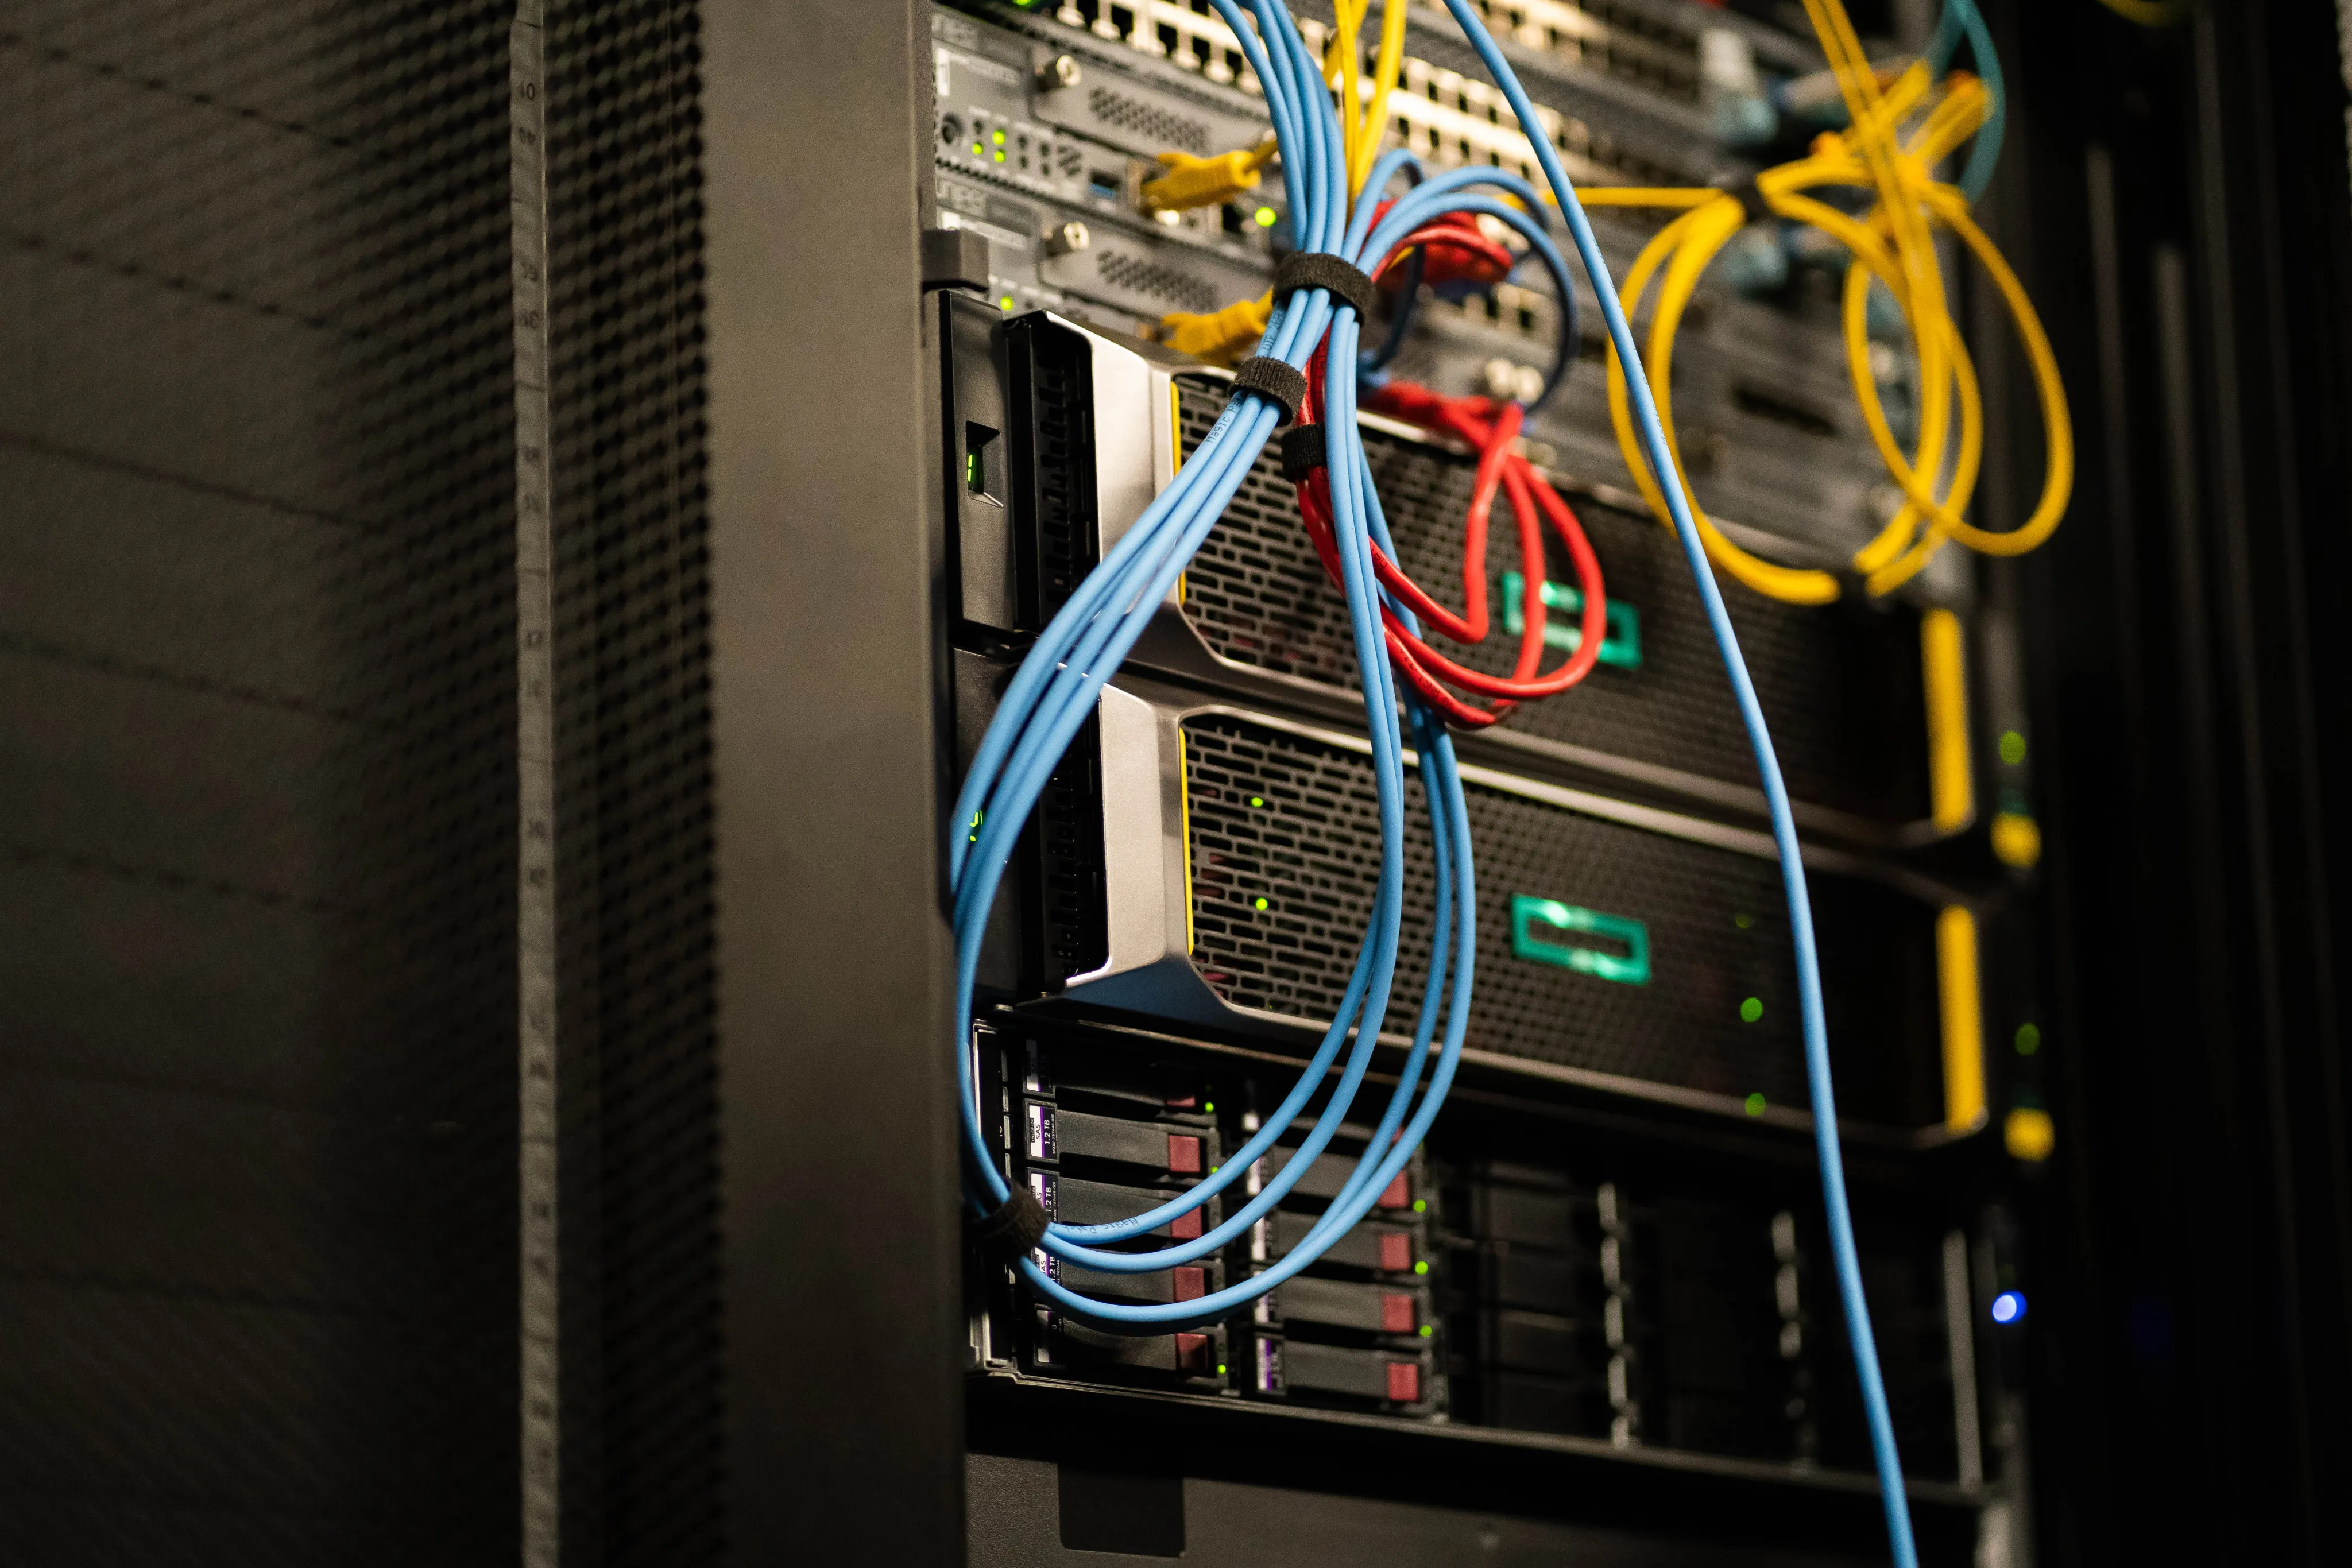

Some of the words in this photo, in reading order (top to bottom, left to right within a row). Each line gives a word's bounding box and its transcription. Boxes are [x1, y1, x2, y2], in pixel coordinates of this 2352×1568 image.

[1205, 416, 1231, 443] Magic
[1044, 1120, 1050, 1129] TB
[1046, 1187, 1051, 1197] TB
[1050, 1256, 1055, 1266] TB
